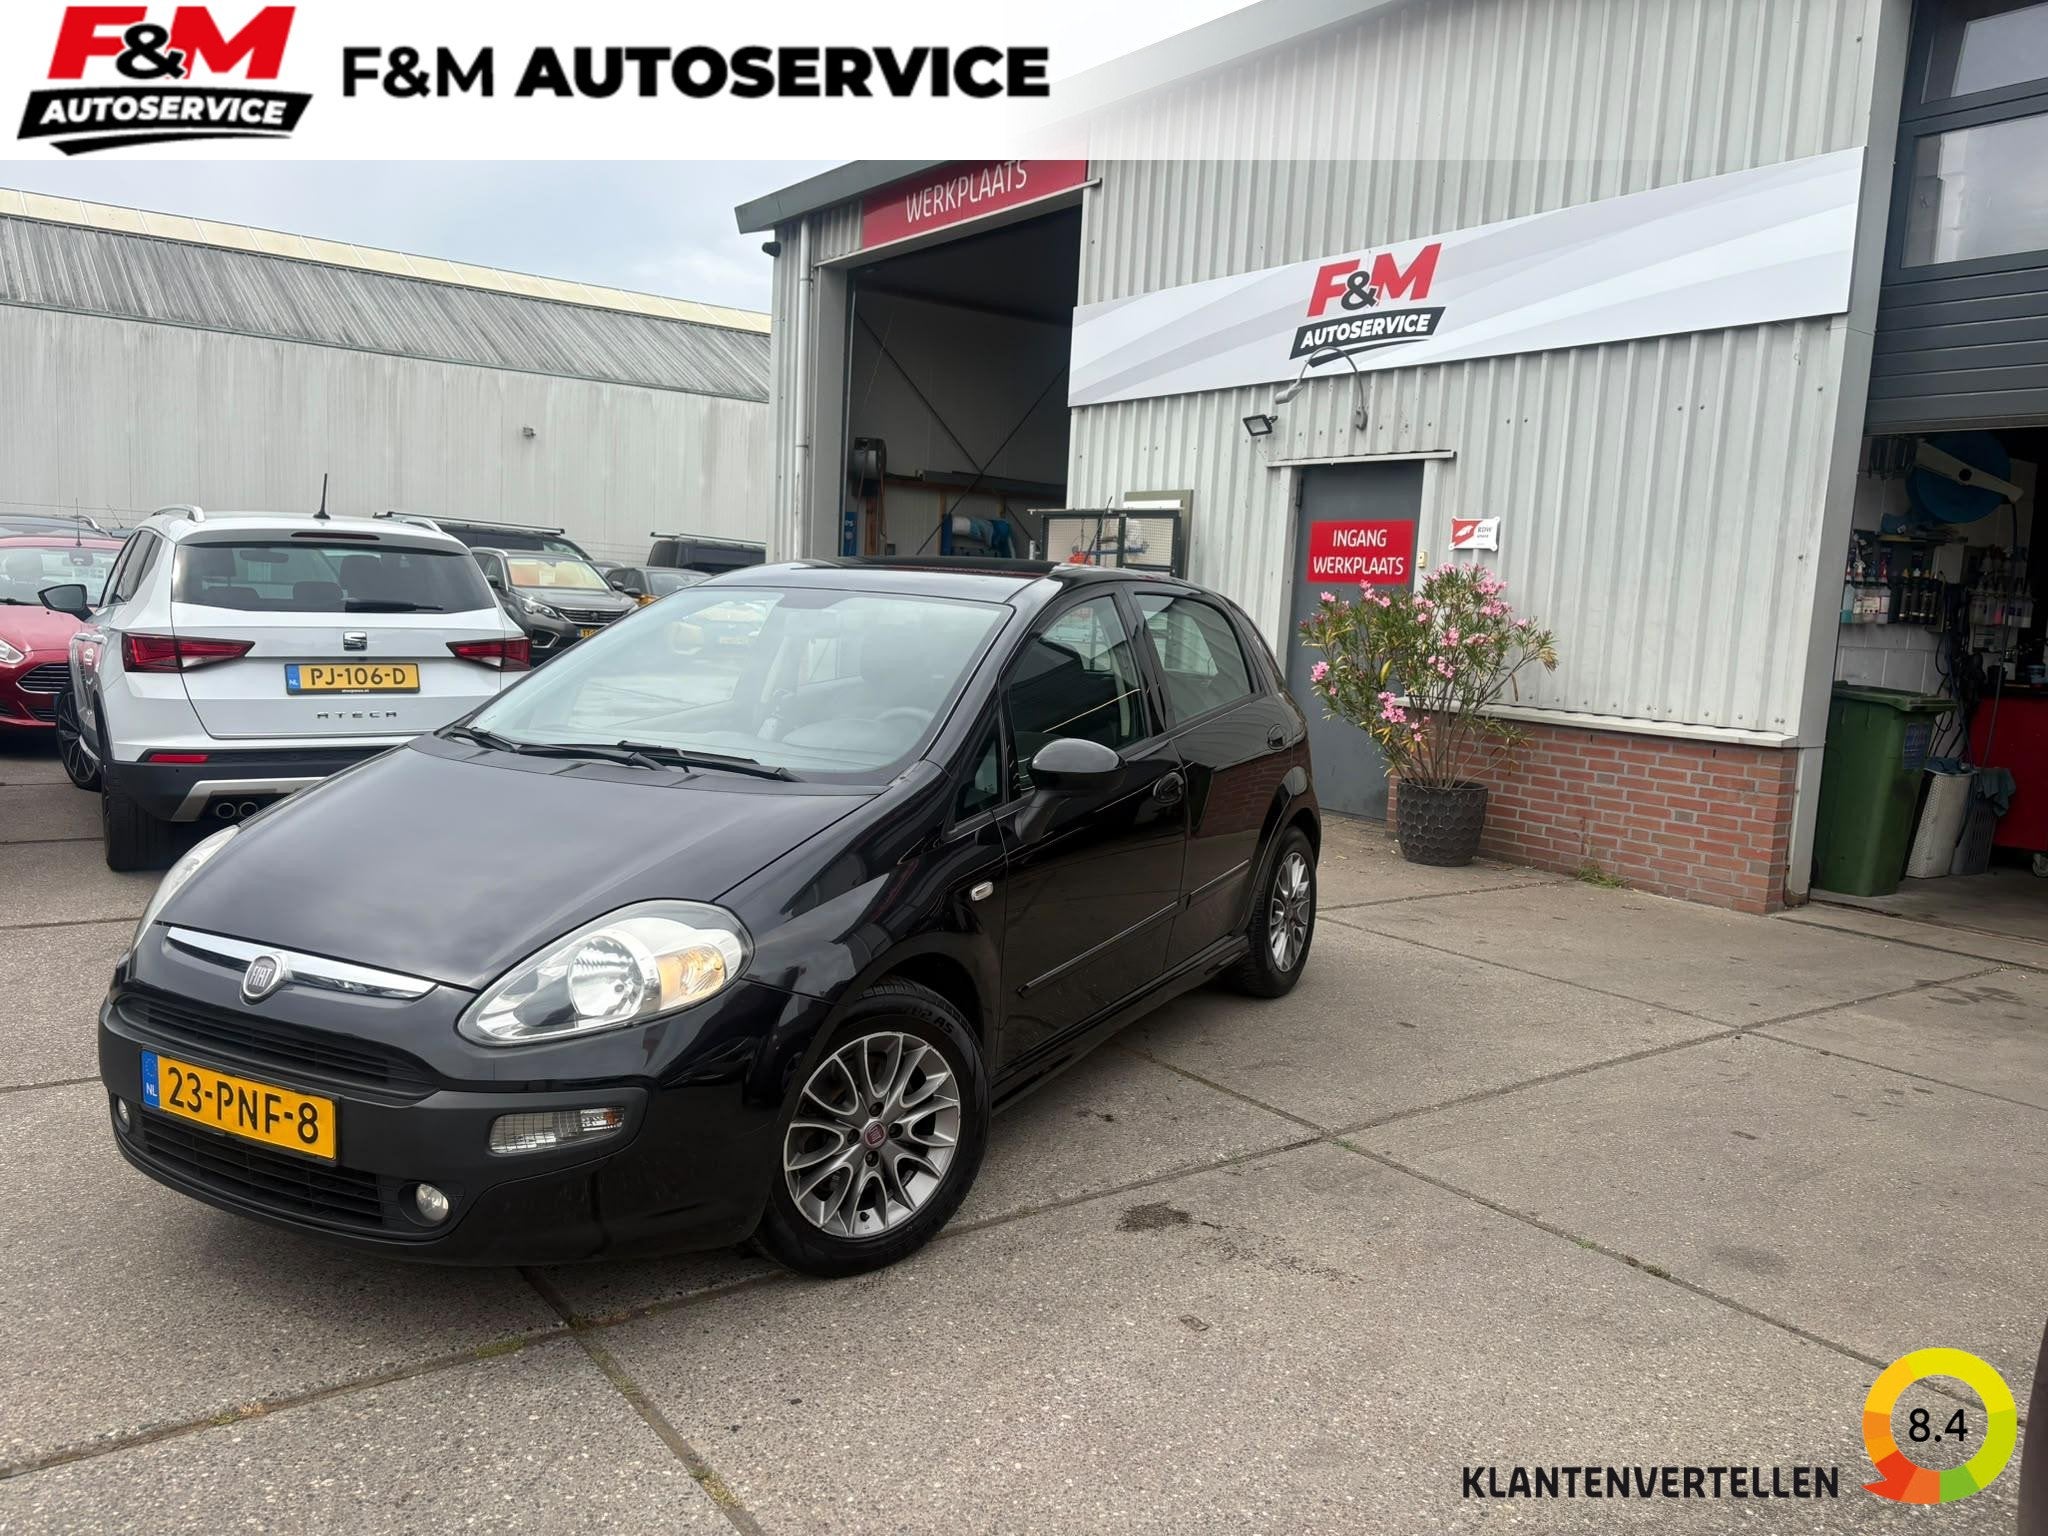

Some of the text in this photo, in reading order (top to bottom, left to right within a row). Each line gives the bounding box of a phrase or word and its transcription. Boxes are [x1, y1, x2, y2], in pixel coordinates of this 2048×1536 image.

[906, 160, 1027, 223] WERKPLAATS
[1306, 243, 1442, 318] F&M
[1300, 313, 1432, 349] AUTOSERVICE
[1332, 529, 1388, 547] INGANG
[1312, 556, 1405, 575] WERKPLAATS
[310, 667, 406, 686] PJ-106-D
[316, 711, 398, 719] ATECA
[248, 965, 273, 988] FIAT
[145, 1082, 158, 1097] NL
[168, 1066, 319, 1145] 23-PNF-8
